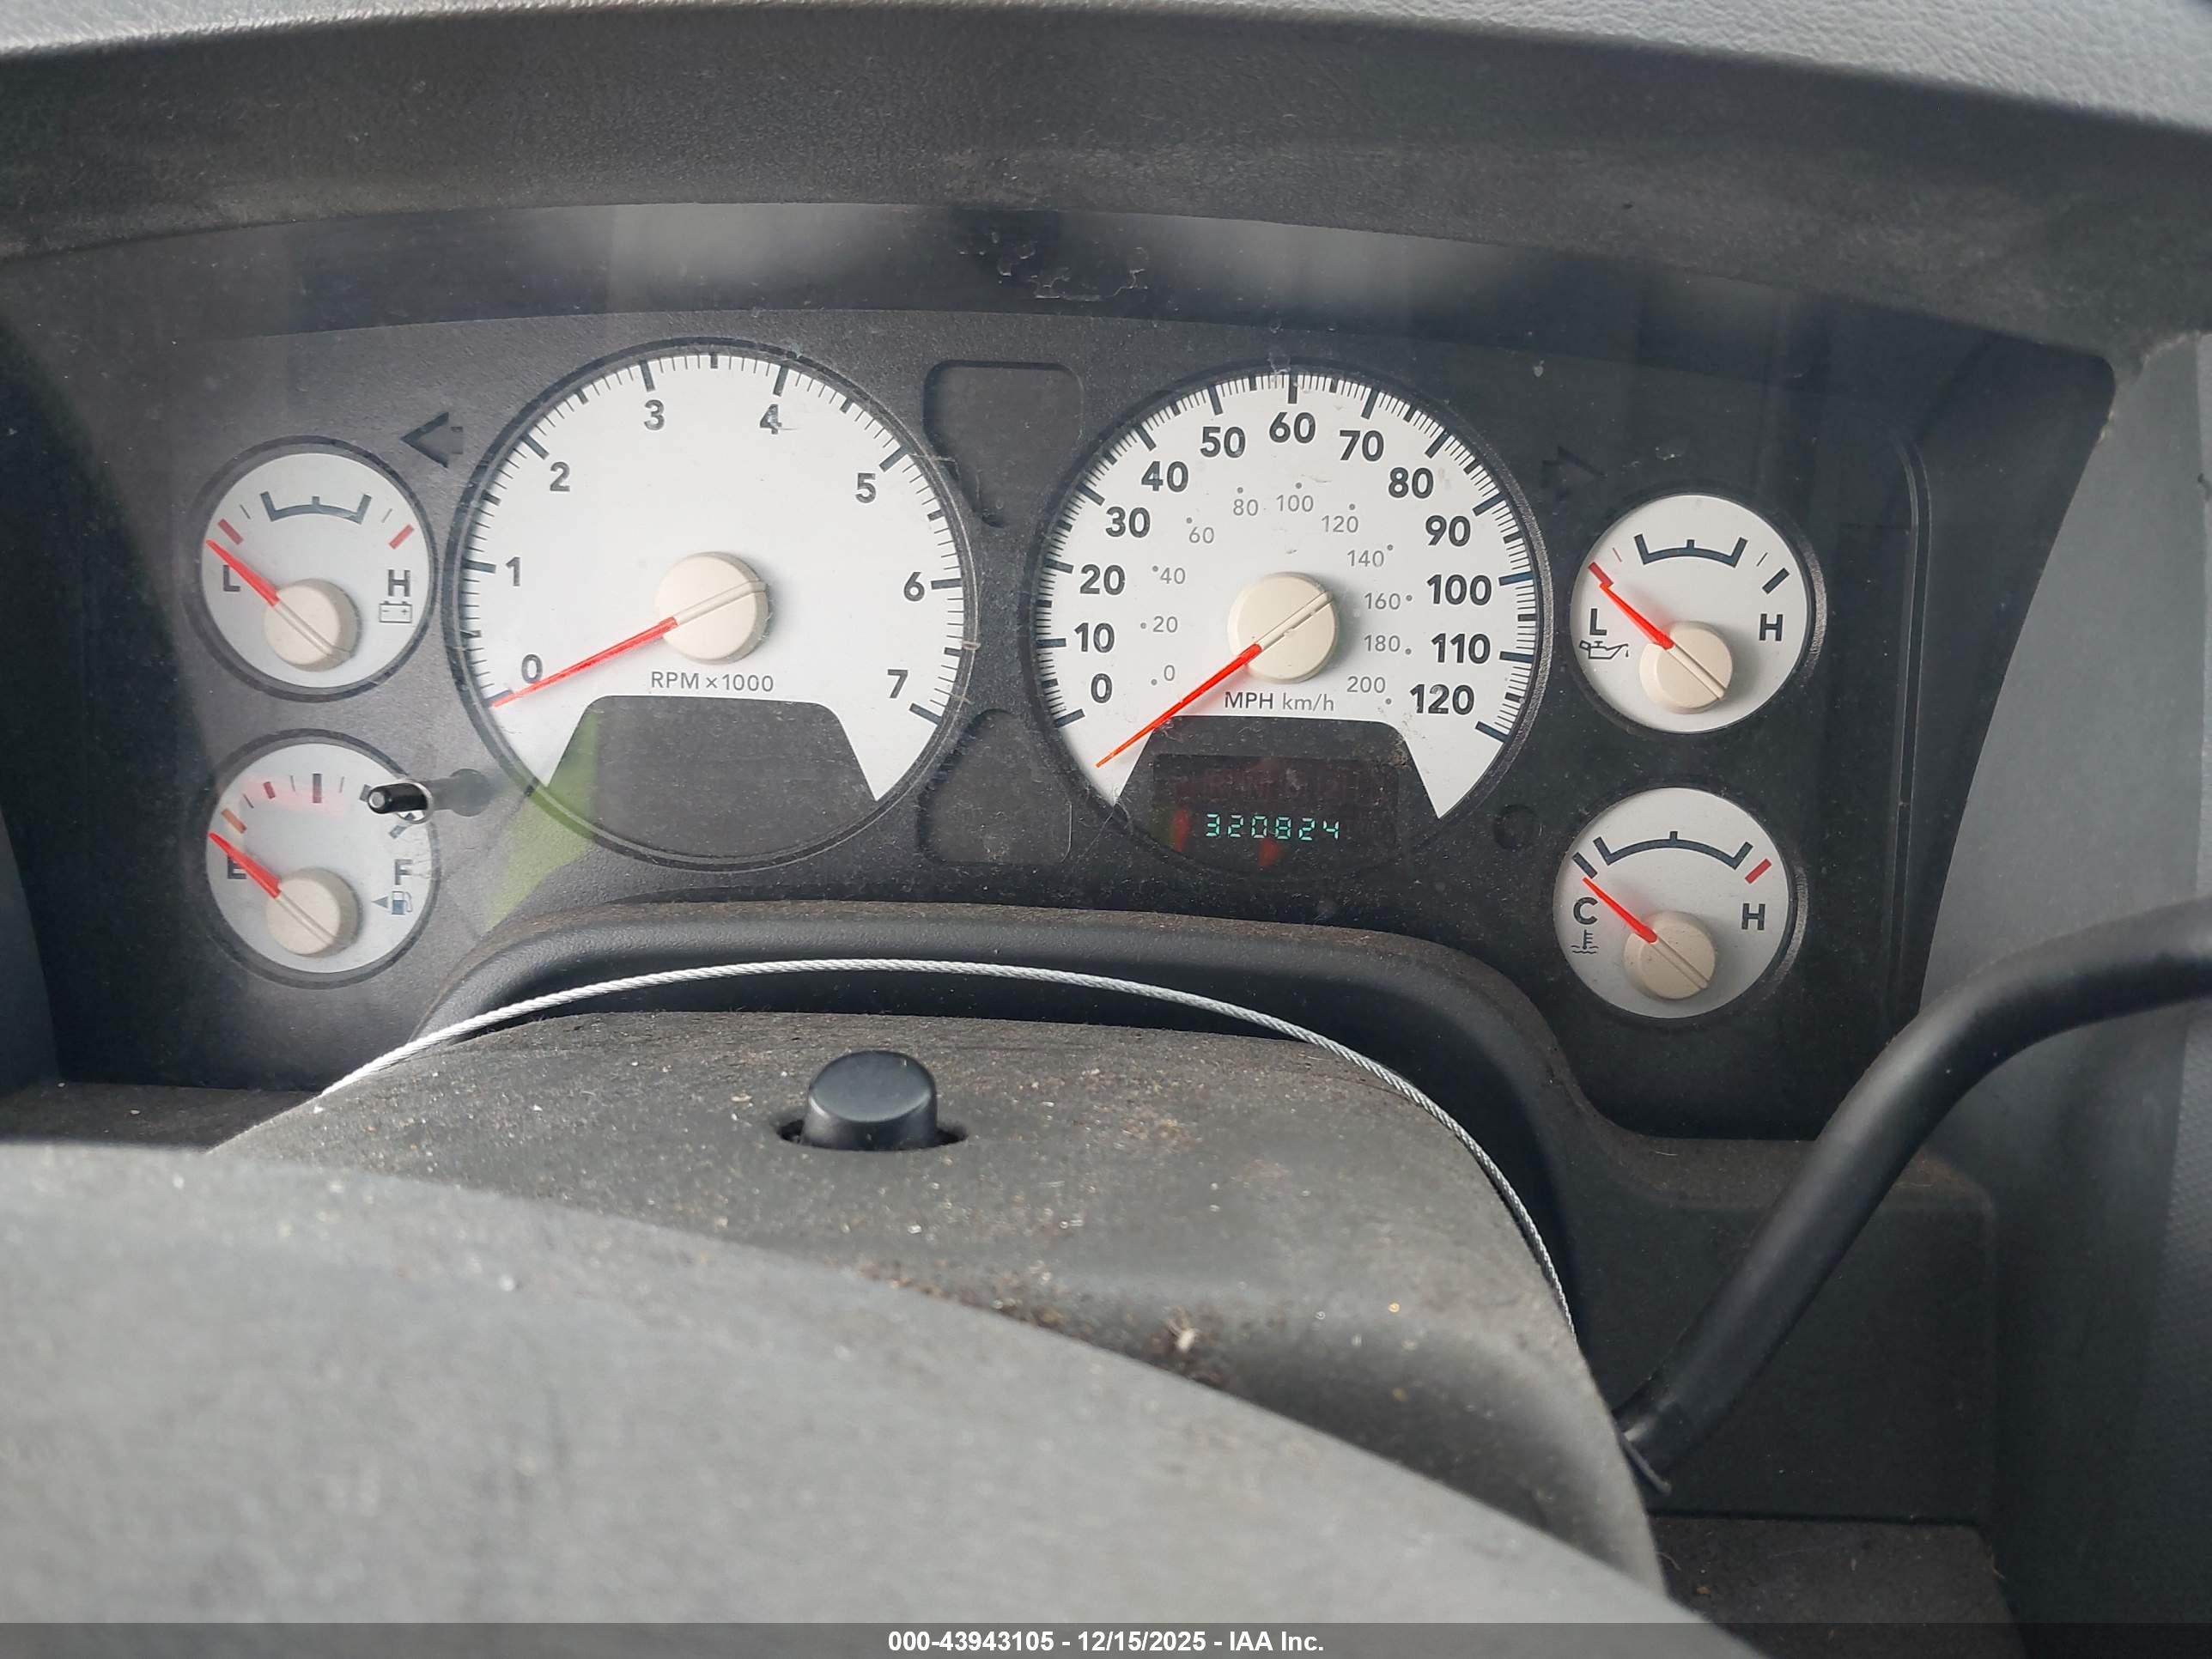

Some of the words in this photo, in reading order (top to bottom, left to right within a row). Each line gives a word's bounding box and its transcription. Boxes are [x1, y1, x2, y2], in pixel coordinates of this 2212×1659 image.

[643, 399, 665, 431] 3
[759, 404, 783, 434] 4
[1268, 412, 1316, 443] 60
[1200, 426, 1247, 459] 50
[1339, 430, 1384, 461] 70
[550, 462, 571, 493] 2
[855, 472, 877, 503] 5
[1141, 461, 1189, 493] 40
[1388, 467, 1434, 499] 80
[1232, 499, 1259, 517] 80
[1276, 495, 1314, 513] 100
[1105, 507, 1151, 538] 30
[1188, 526, 1214, 544] 60
[1321, 516, 1358, 533] 120
[1425, 515, 1471, 548] 90
[505, 556, 521, 587] 1
[1347, 550, 1384, 568] 140
[223, 564, 240, 592] L
[387, 569, 410, 597] H
[903, 572, 926, 603] 6
[1079, 563, 1127, 596] 20
[1159, 568, 1186, 586] 40
[1426, 574, 1492, 606] 100
[1364, 592, 1401, 610] 160
[1152, 617, 1178, 634] 20
[1589, 608, 1607, 635] L
[1759, 613, 1784, 641] H
[1073, 623, 1115, 653] 10
[1364, 635, 1401, 653] 180
[1431, 633, 1491, 665] 110
[520, 654, 544, 684] 0
[651, 672, 700, 690] RPM
[886, 669, 909, 699] 7
[1163, 665, 1176, 682] 0
[1091, 673, 1113, 704] 0
[1346, 676, 1386, 694] 200
[1410, 684, 1475, 714] 120
[1224, 692, 1274, 711] MPH
[1283, 693, 1334, 712] km/h
[1206, 813, 1340, 841] 320824
[394, 859, 414, 885] F
[1573, 896, 1599, 926] C
[1741, 902, 1765, 931] H
